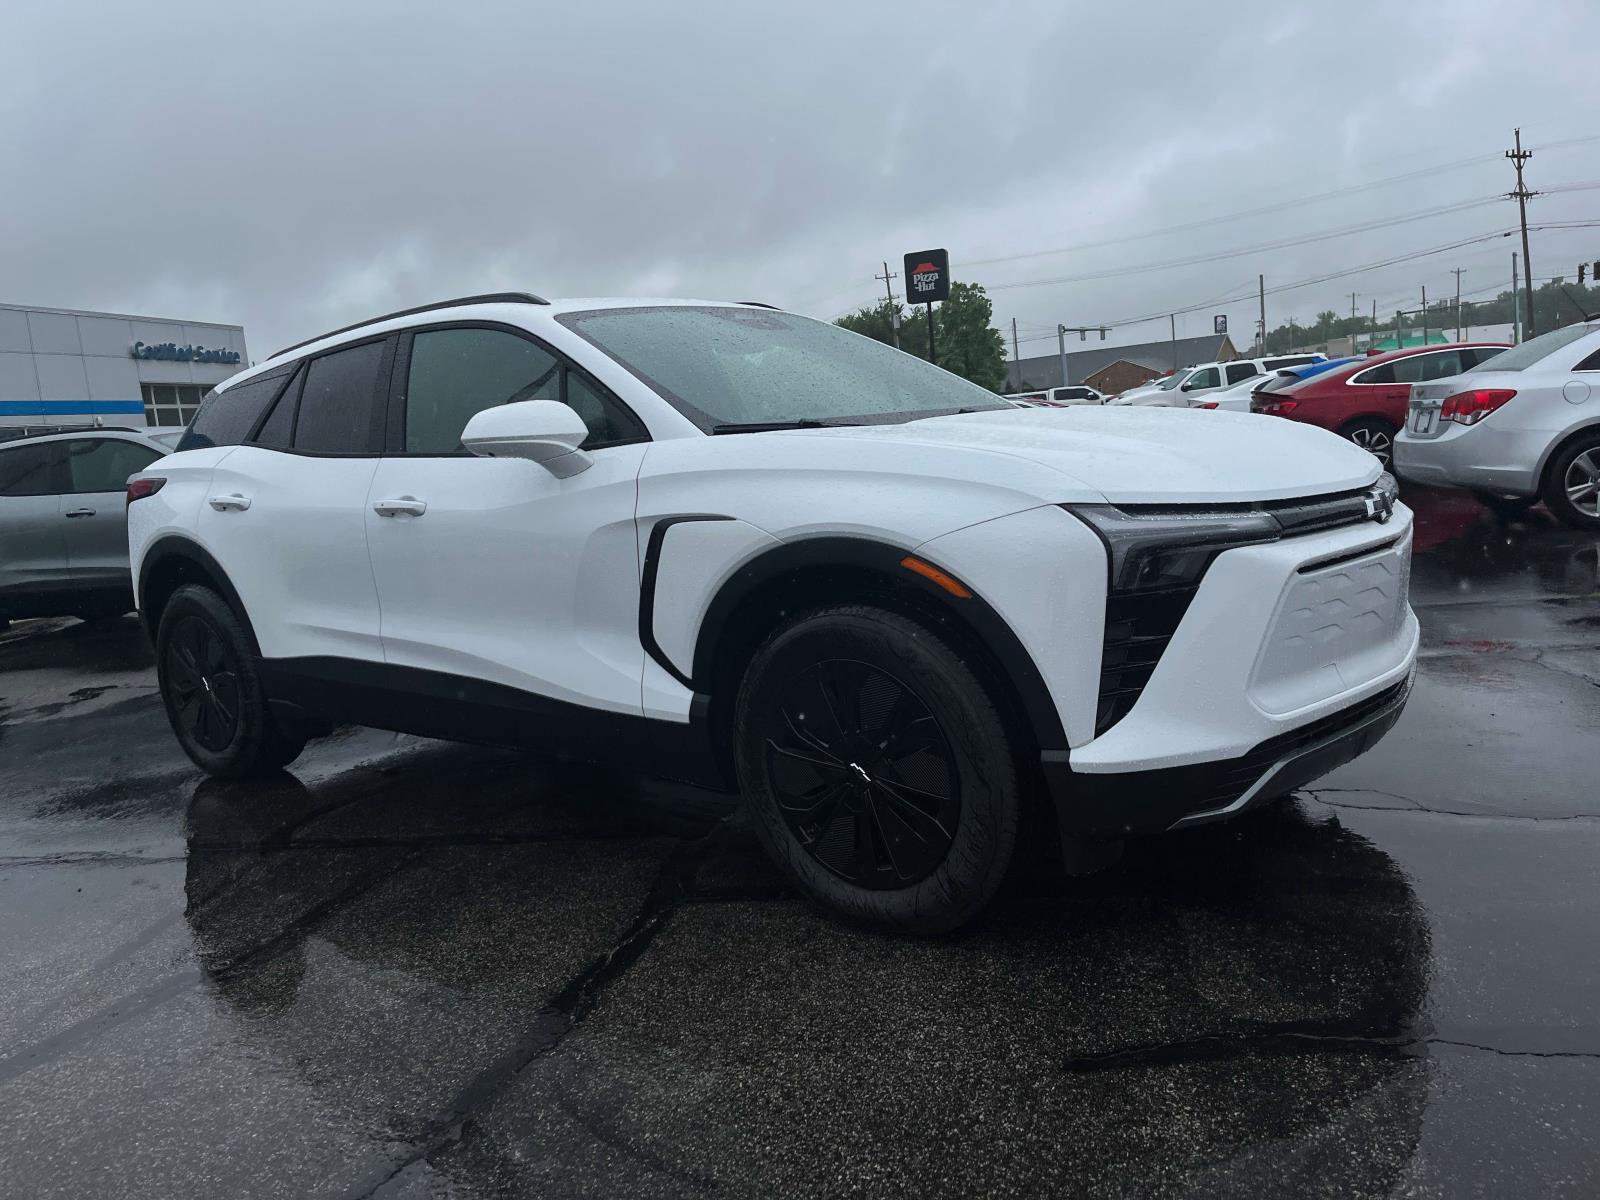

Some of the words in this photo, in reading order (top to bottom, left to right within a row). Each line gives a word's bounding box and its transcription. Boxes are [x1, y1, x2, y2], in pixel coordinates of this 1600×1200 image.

[913, 273, 939, 284] Pizza
[915, 281, 936, 292] Hut
[132, 341, 193, 361] Certified
[193, 346, 241, 364] Service
